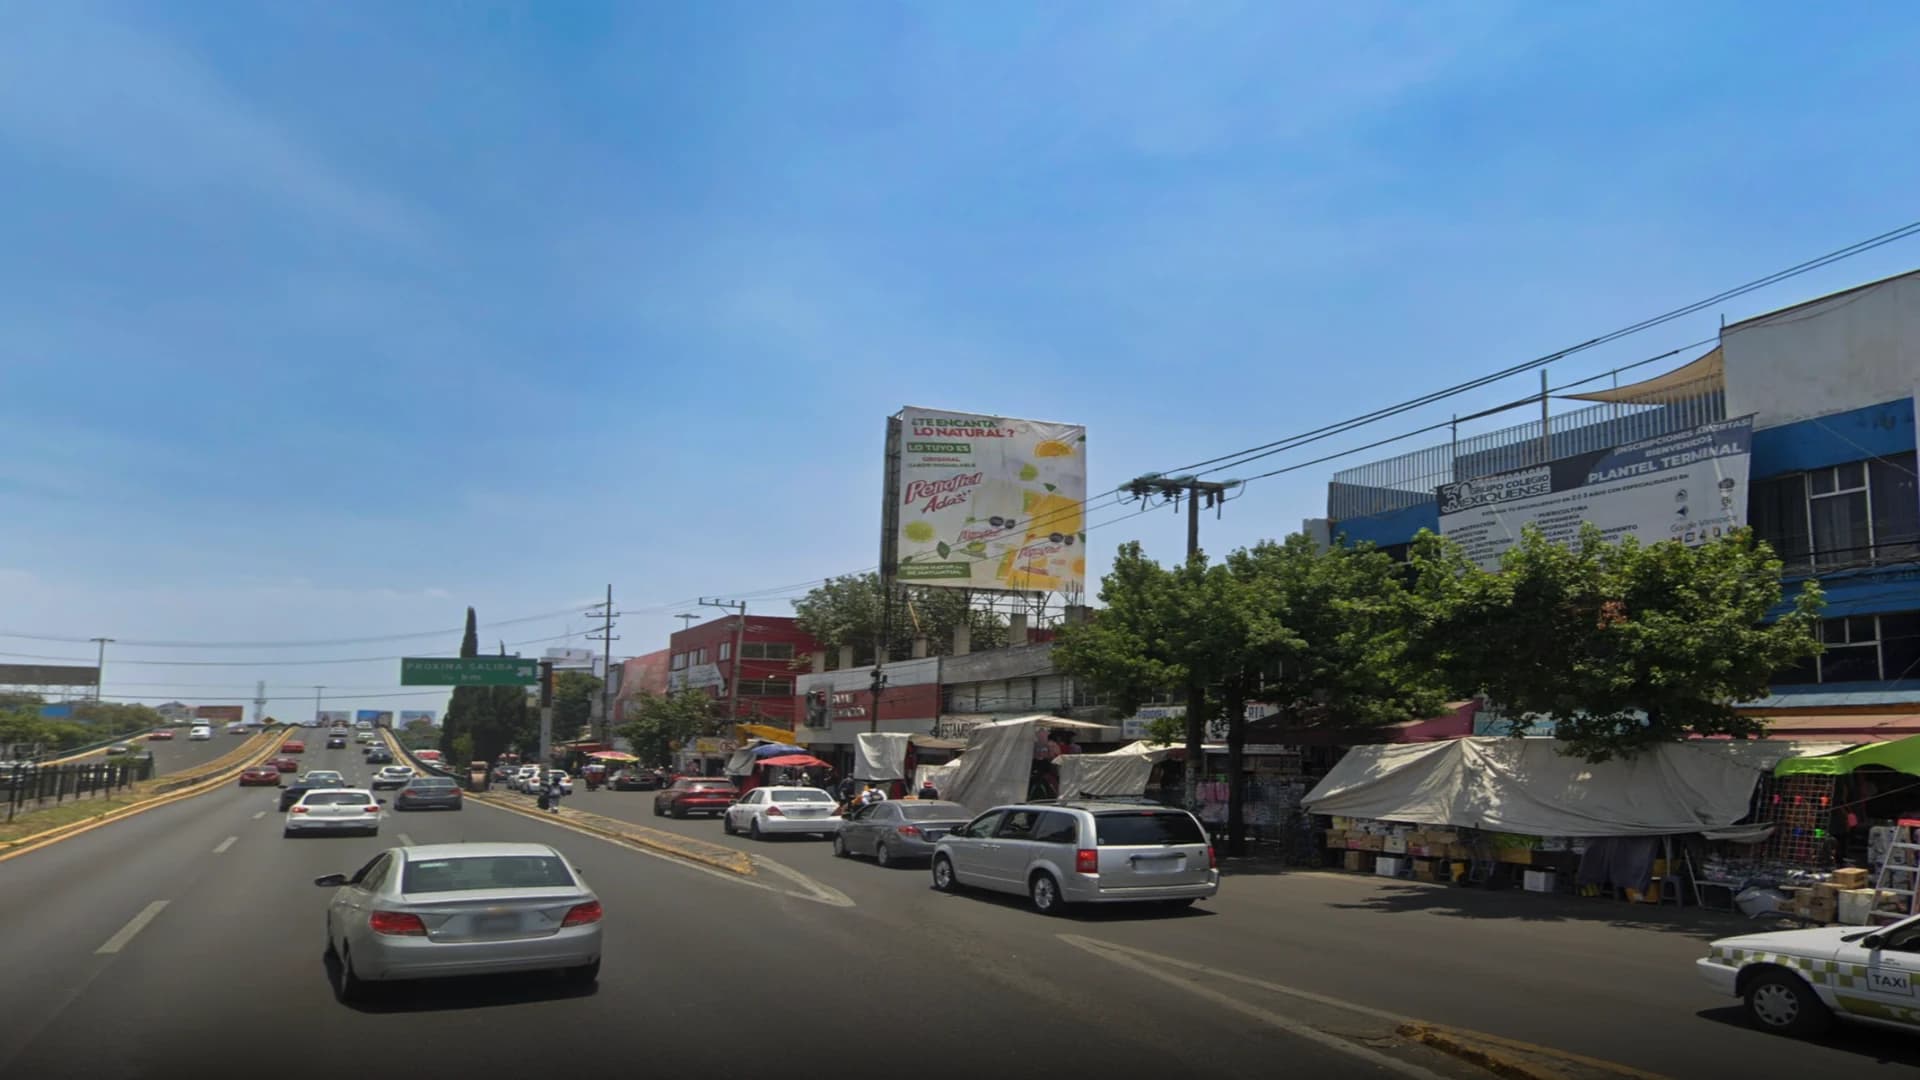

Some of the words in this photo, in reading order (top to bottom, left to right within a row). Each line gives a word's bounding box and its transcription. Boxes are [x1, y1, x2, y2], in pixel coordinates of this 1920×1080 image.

[935, 418, 998, 428] ENCANTA
[913, 427, 934, 436] LO
[908, 443, 922, 451] LO
[926, 443, 954, 452] TUYO
[1587, 460, 1658, 484] PLANTEL
[1660, 441, 1743, 469] TERMINAL
[1505, 474, 1550, 490] COLEGIO
[1441, 482, 1551, 513] MEXIQUENSE
[1872, 974, 1907, 988] TAXI
